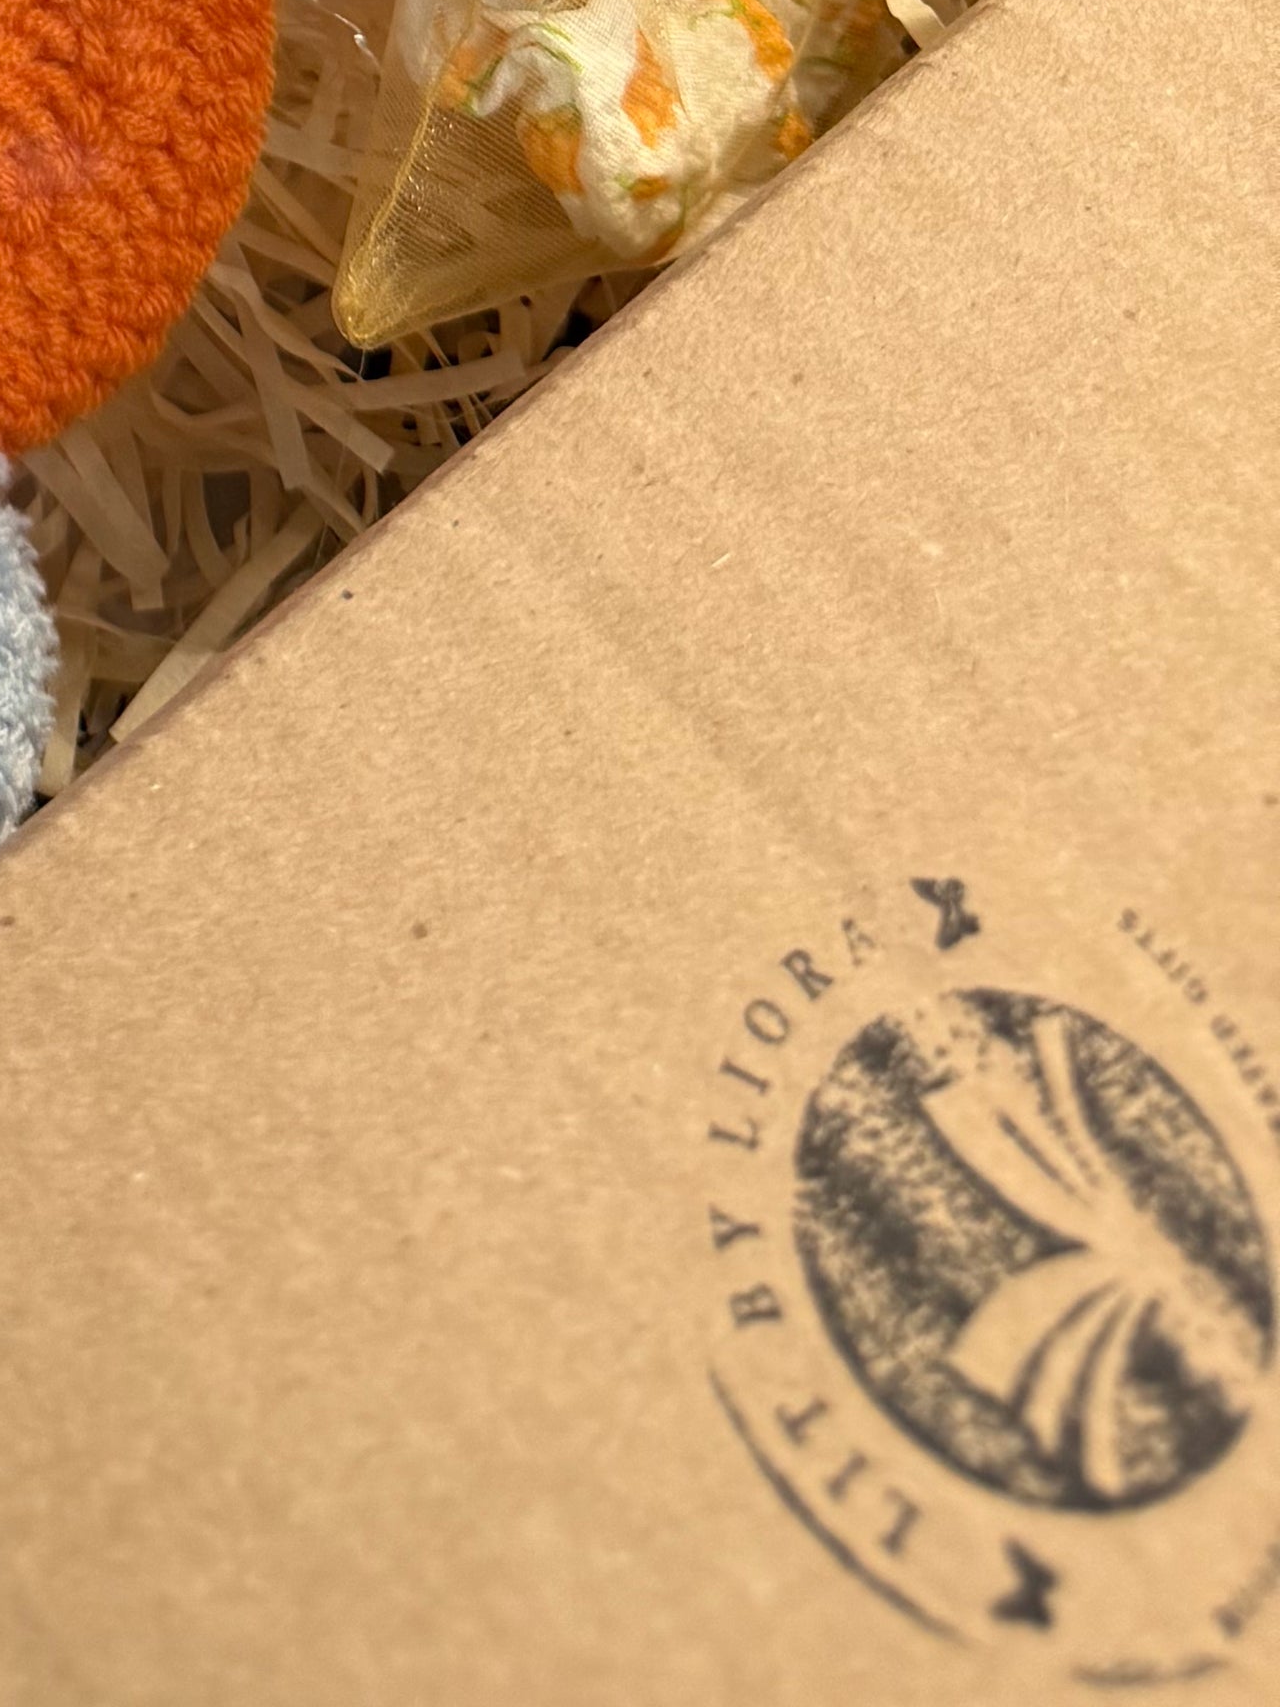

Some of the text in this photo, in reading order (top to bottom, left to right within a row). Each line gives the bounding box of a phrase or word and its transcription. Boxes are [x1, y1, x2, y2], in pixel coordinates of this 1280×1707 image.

[707, 916, 923, 1558] LIT BY LIORA
